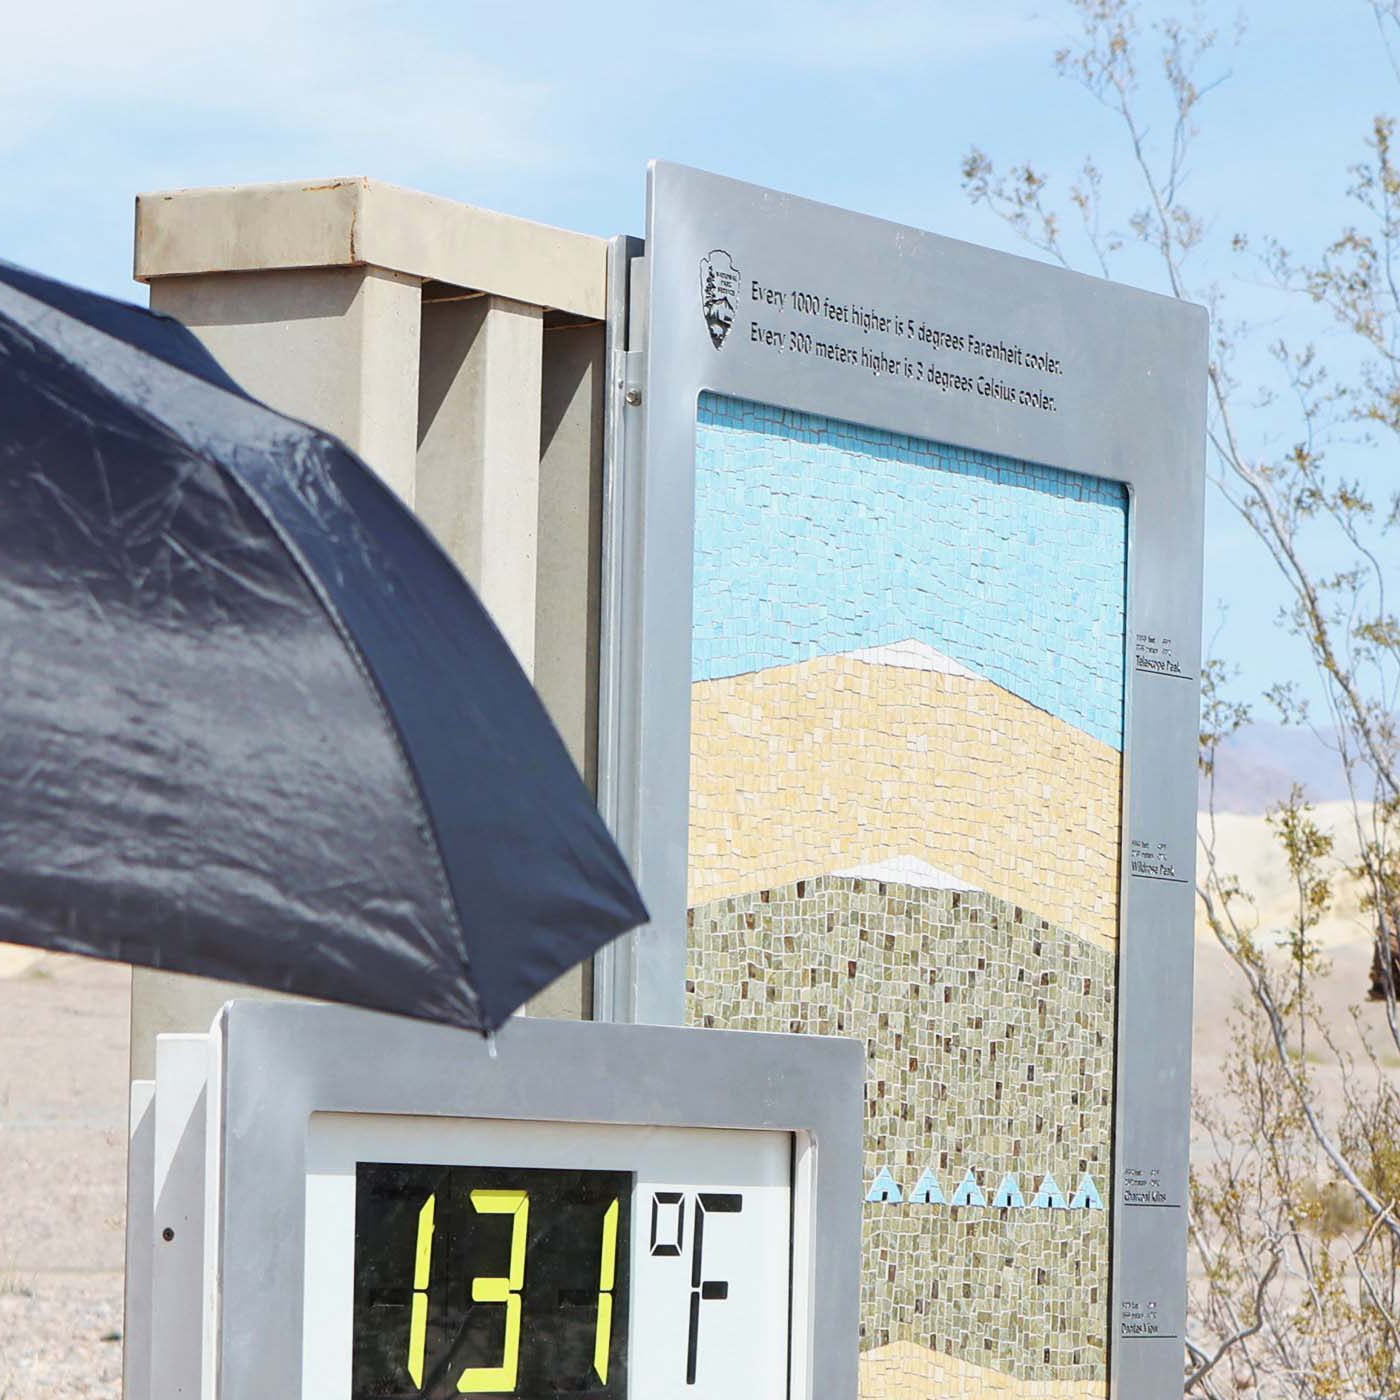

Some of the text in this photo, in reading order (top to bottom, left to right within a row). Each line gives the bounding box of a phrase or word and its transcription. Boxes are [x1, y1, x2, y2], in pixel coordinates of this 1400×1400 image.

[751, 321, 1057, 412] Every 300 meters higher is 3 degrees Celsius cooler.
[752, 281, 1063, 375] Every 1000 feet higher is 5 degrees Farenheit cooler.
